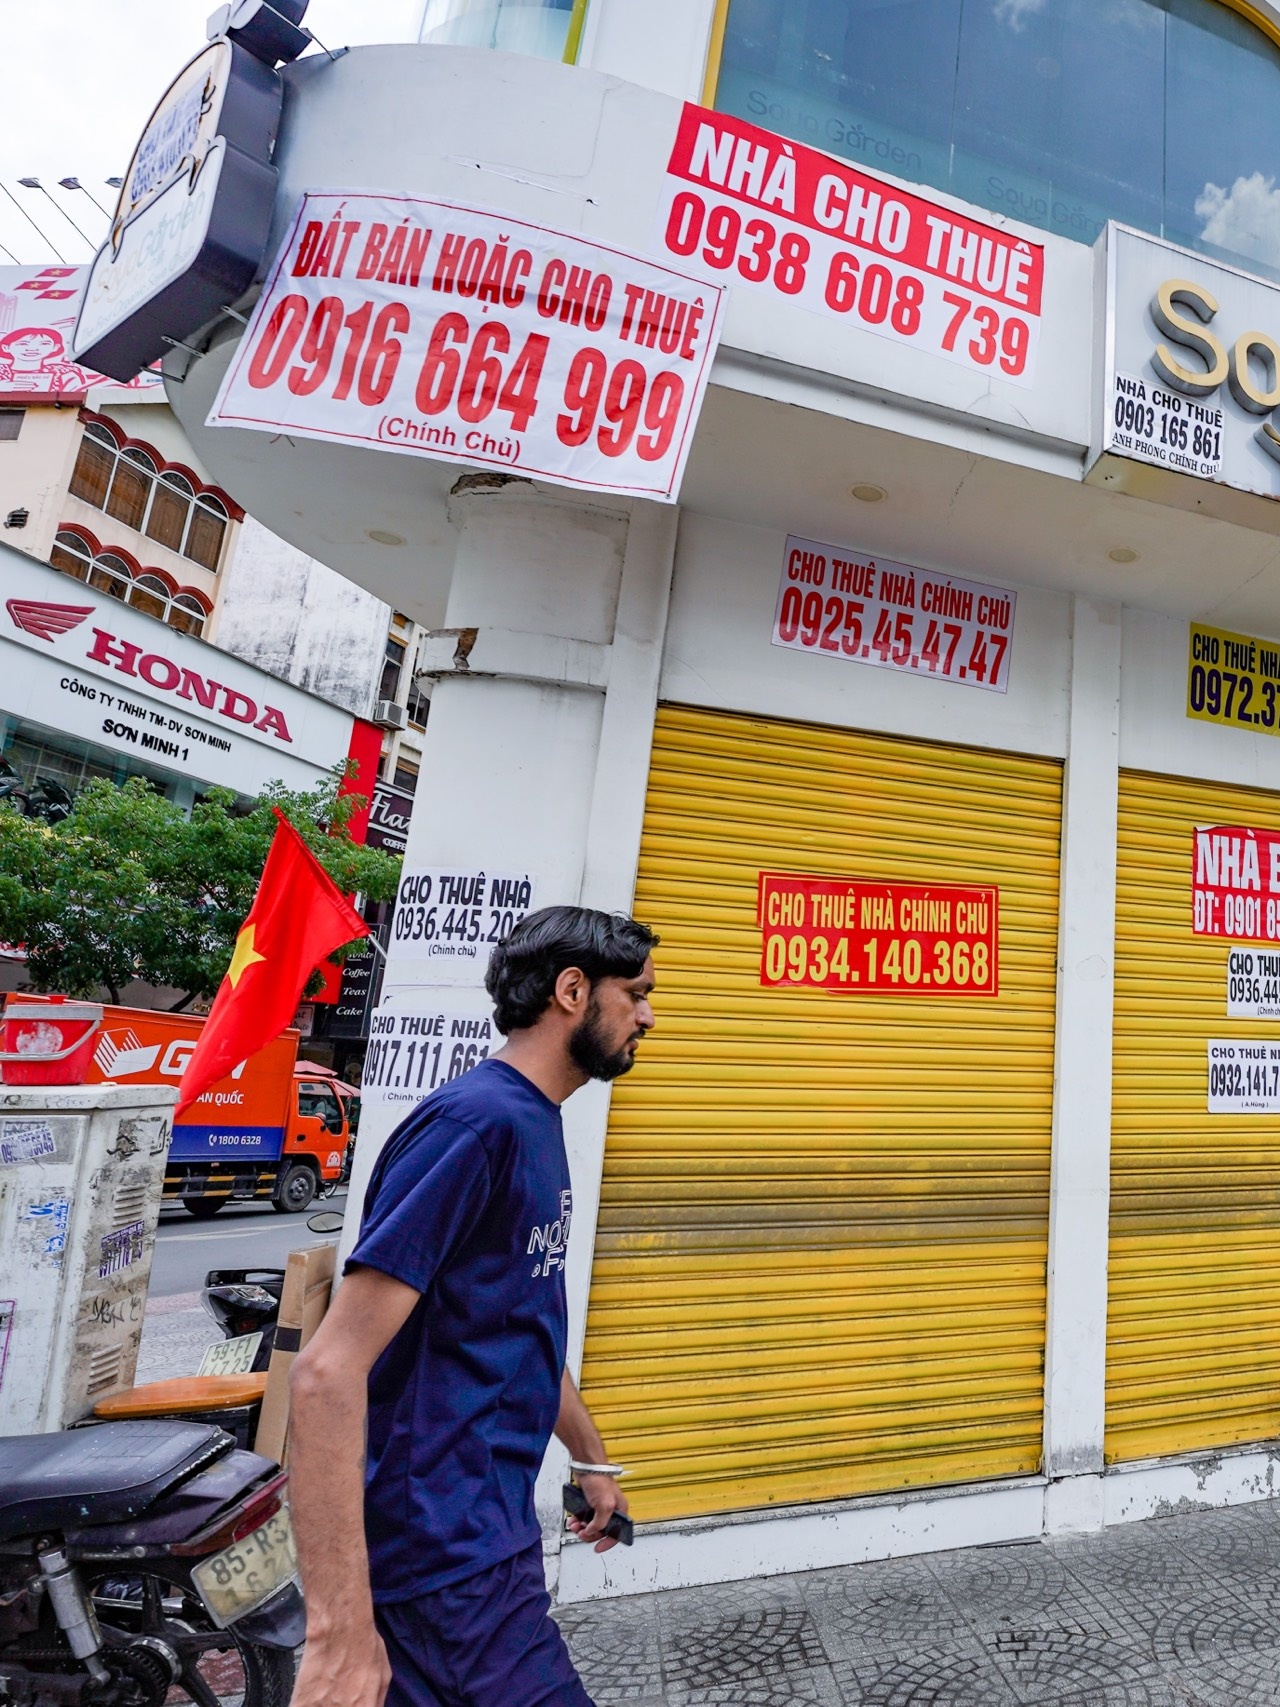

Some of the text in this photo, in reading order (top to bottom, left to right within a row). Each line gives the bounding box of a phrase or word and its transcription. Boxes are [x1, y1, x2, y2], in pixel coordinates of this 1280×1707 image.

[688, 121, 1033, 305] NHÀ CHO THUÊ
[292, 201, 704, 361] ĐẤT BÁN HOẶC CHO THUÊ
[664, 191, 1030, 375] 0938 608 739
[248, 293, 684, 462] 0916 664 999
[1116, 376, 1223, 428] NHÀ CHO THUÊ
[378, 416, 522, 464] (Chính Chủ)
[1112, 432, 1198, 472] ANH PHONG CHÍNH
[1115, 396, 1221, 461] 0903 165 861
[788, 549, 1011, 630] CHO THUÊ NHÀ CHÍNH CHỦ
[778, 586, 1008, 686] 0925.45.47.47
[1192, 632, 1220, 665] CHO
[1223, 640, 1256, 674] THUÊ
[86, 627, 293, 743] HONDA
[60, 677, 97, 702] CÔNG
[98, 691, 114, 708] TY
[117, 697, 147, 720] TNHH
[184, 726, 207, 744] SƠN
[207, 732, 232, 753] MINH
[101, 717, 190, 761] SƠN MINH 1
[1196, 828, 1261, 891] NHÀ
[400, 872, 532, 909] CHO THUÊ NHÀ
[768, 887, 988, 935] CHO THUÊ NHÀ CHÍNH CHỦ
[1194, 890, 1220, 934] ĐT:
[1225, 893, 1262, 938] 0901
[342, 968, 371, 978] Coffee
[428, 944, 477, 958] (Chính chủ)
[765, 934, 989, 986] 0934.140.368
[1229, 952, 1253, 977] CHO
[335, 1006, 363, 1016] Cake
[343, 987, 367, 996] Teas
[371, 1014, 492, 1040] CHO THUÊ NHÀ
[1211, 1046, 1235, 1059] CHO
[1238, 1045, 1267, 1060] THUÊ
[215, 1090, 244, 1106] QUỐC
[218, 1136, 261, 1145] 1800 6328
[211, 1518, 288, 1585] 85-R3
